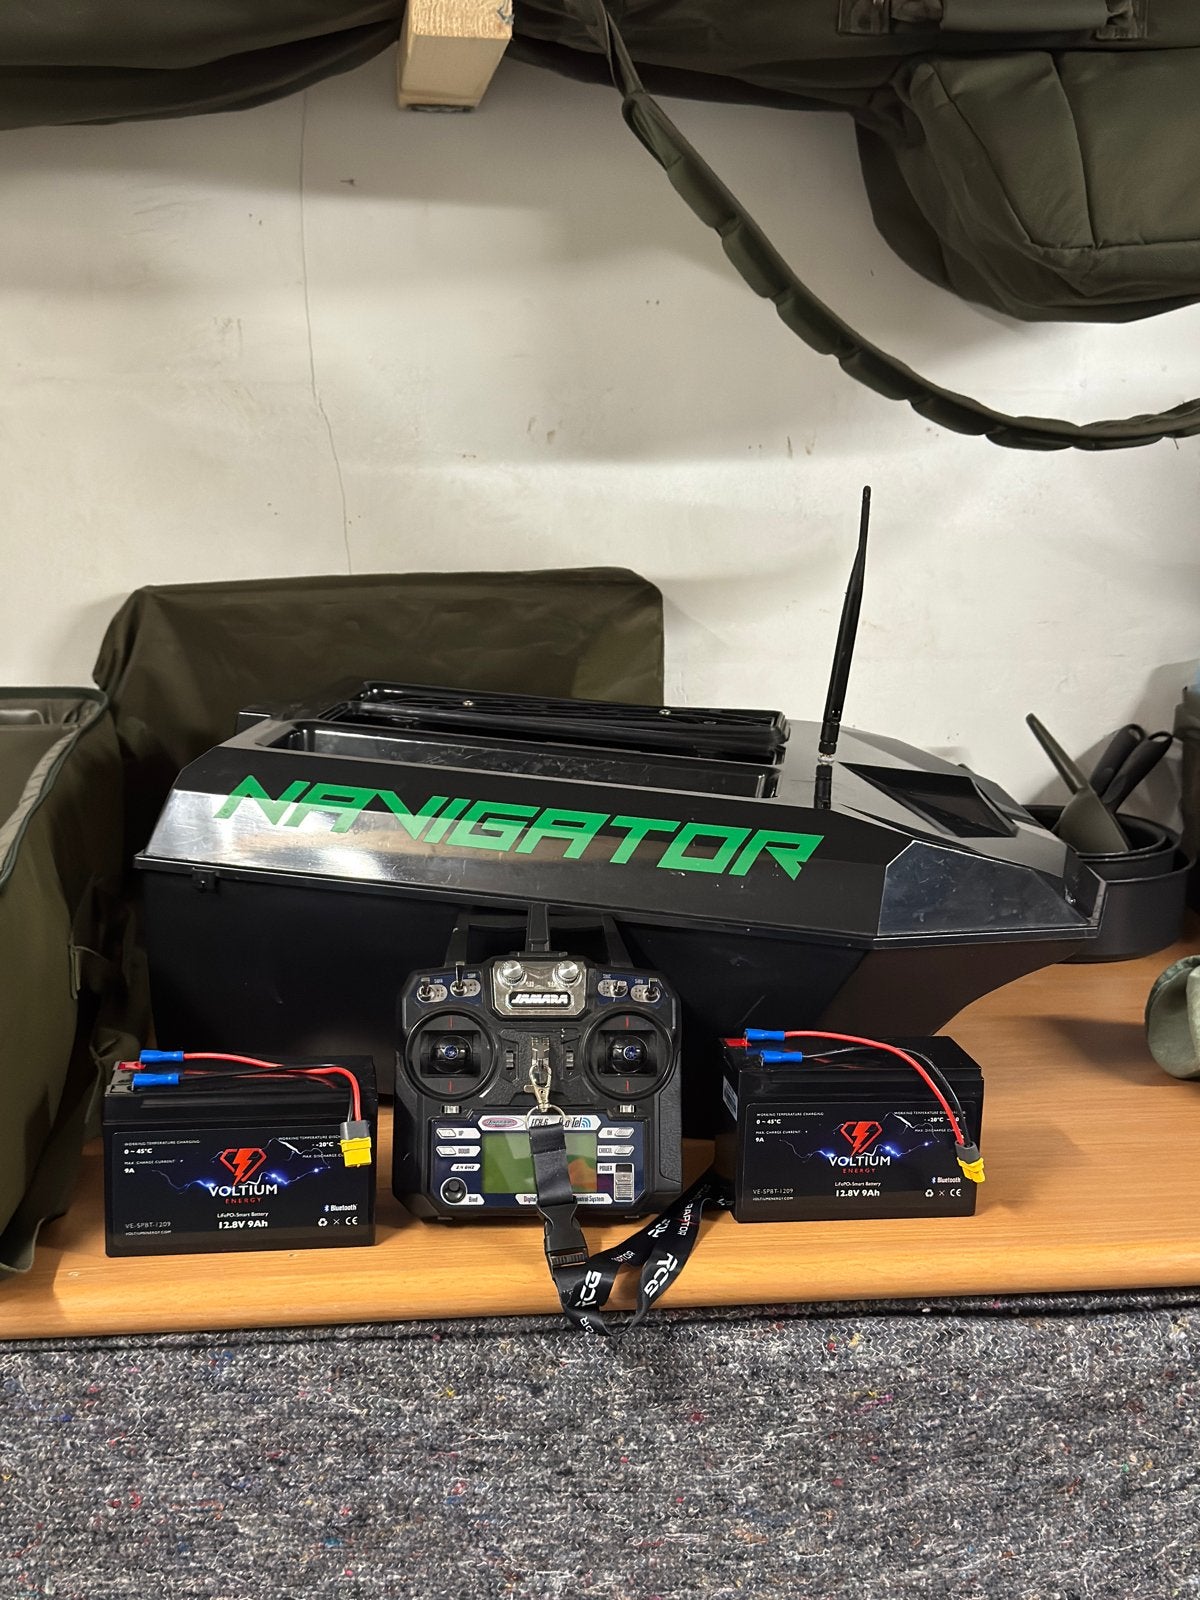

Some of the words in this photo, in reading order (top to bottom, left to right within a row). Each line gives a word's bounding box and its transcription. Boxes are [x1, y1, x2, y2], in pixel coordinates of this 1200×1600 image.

[213, 774, 825, 882] NAVIGATOR
[828, 1155, 891, 1167] VOLTIUM
[208, 1184, 278, 1197] VOLTIUM
[835, 1189, 860, 1198] 12.8V
[861, 1189, 881, 1197] 9Ah
[225, 1197, 262, 1205] ENERGY
[218, 1220, 246, 1229] 12.8V
[247, 1219, 269, 1228] 9Ah
[643, 1252, 679, 1298] RCG
